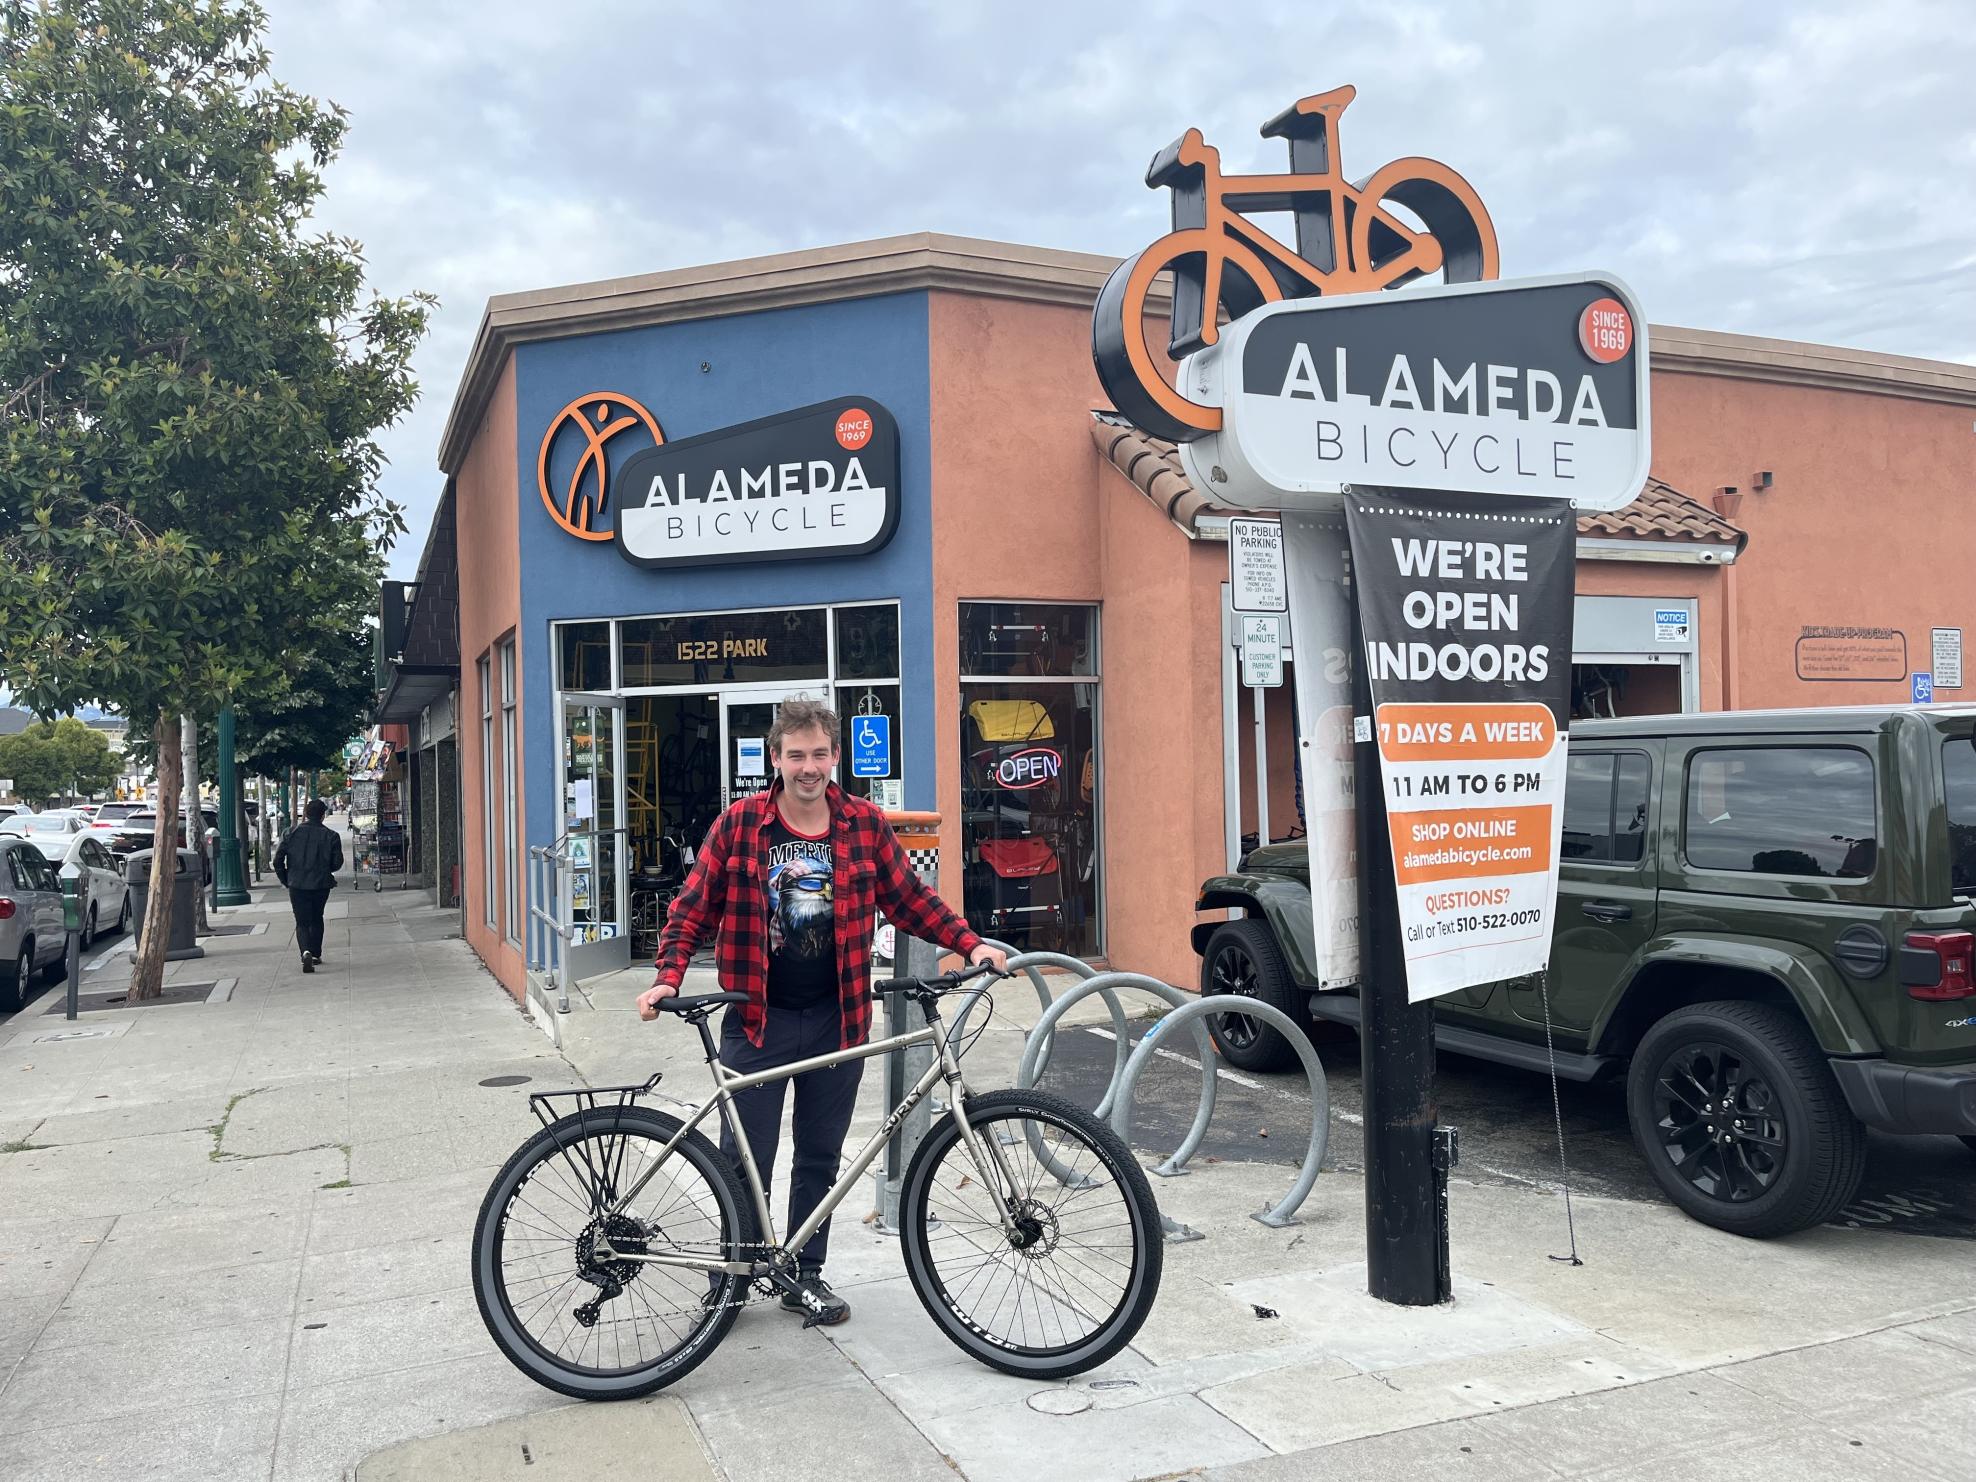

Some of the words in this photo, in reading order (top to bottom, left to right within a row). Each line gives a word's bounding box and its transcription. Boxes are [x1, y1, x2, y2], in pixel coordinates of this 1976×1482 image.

[1592, 311, 1625, 330] SINCE
[1593, 328, 1626, 351] 1969
[1280, 342, 1609, 429] ALAMEDA
[838, 420, 870, 433] SINCE
[842, 431, 866, 442] 1969
[1316, 421, 1576, 479] BICYCLE
[644, 457, 871, 508] ALAMEDA
[667, 504, 846, 539] BICYCLE
[1236, 525, 1248, 536] NO
[1252, 526, 1282, 537] PUBLIC
[1240, 537, 1277, 549] PARKING
[1392, 538, 1529, 582] WE'RE
[1402, 591, 1519, 631] OPEN
[1657, 612, 1686, 622] NOTICE
[1248, 634, 1276, 643] MINUTE
[1256, 624, 1266, 632] 24
[677, 641, 719, 661] 1522
[723, 638, 768, 658] PARK
[1368, 642, 1550, 683] INDOORS
[1380, 723, 1390, 744] 7
[1397, 722, 1451, 744] DAYS
[1458, 722, 1477, 743] A
[1484, 721, 1544, 743] WEEK
[1000, 756, 1058, 782] OPEN
[752, 776, 768, 788] Open
[1393, 777, 1411, 797] 11
[1420, 776, 1450, 796] AM
[1457, 774, 1488, 795] TO
[1495, 773, 1507, 793] 6
[1514, 773, 1541, 792] PM
[1412, 823, 1449, 842] SHOP
[1453, 820, 1516, 838] ONLINE
[1403, 846, 1532, 869] alamedabicycle.com
[1425, 888, 1511, 915] QUESTIONS?
[1407, 924, 1424, 942] Call
[1426, 926, 1436, 938] or
[1437, 921, 1455, 938] Text
[1456, 909, 1541, 933] 510-522-0070
[882, 1086, 921, 1136] SURLY
